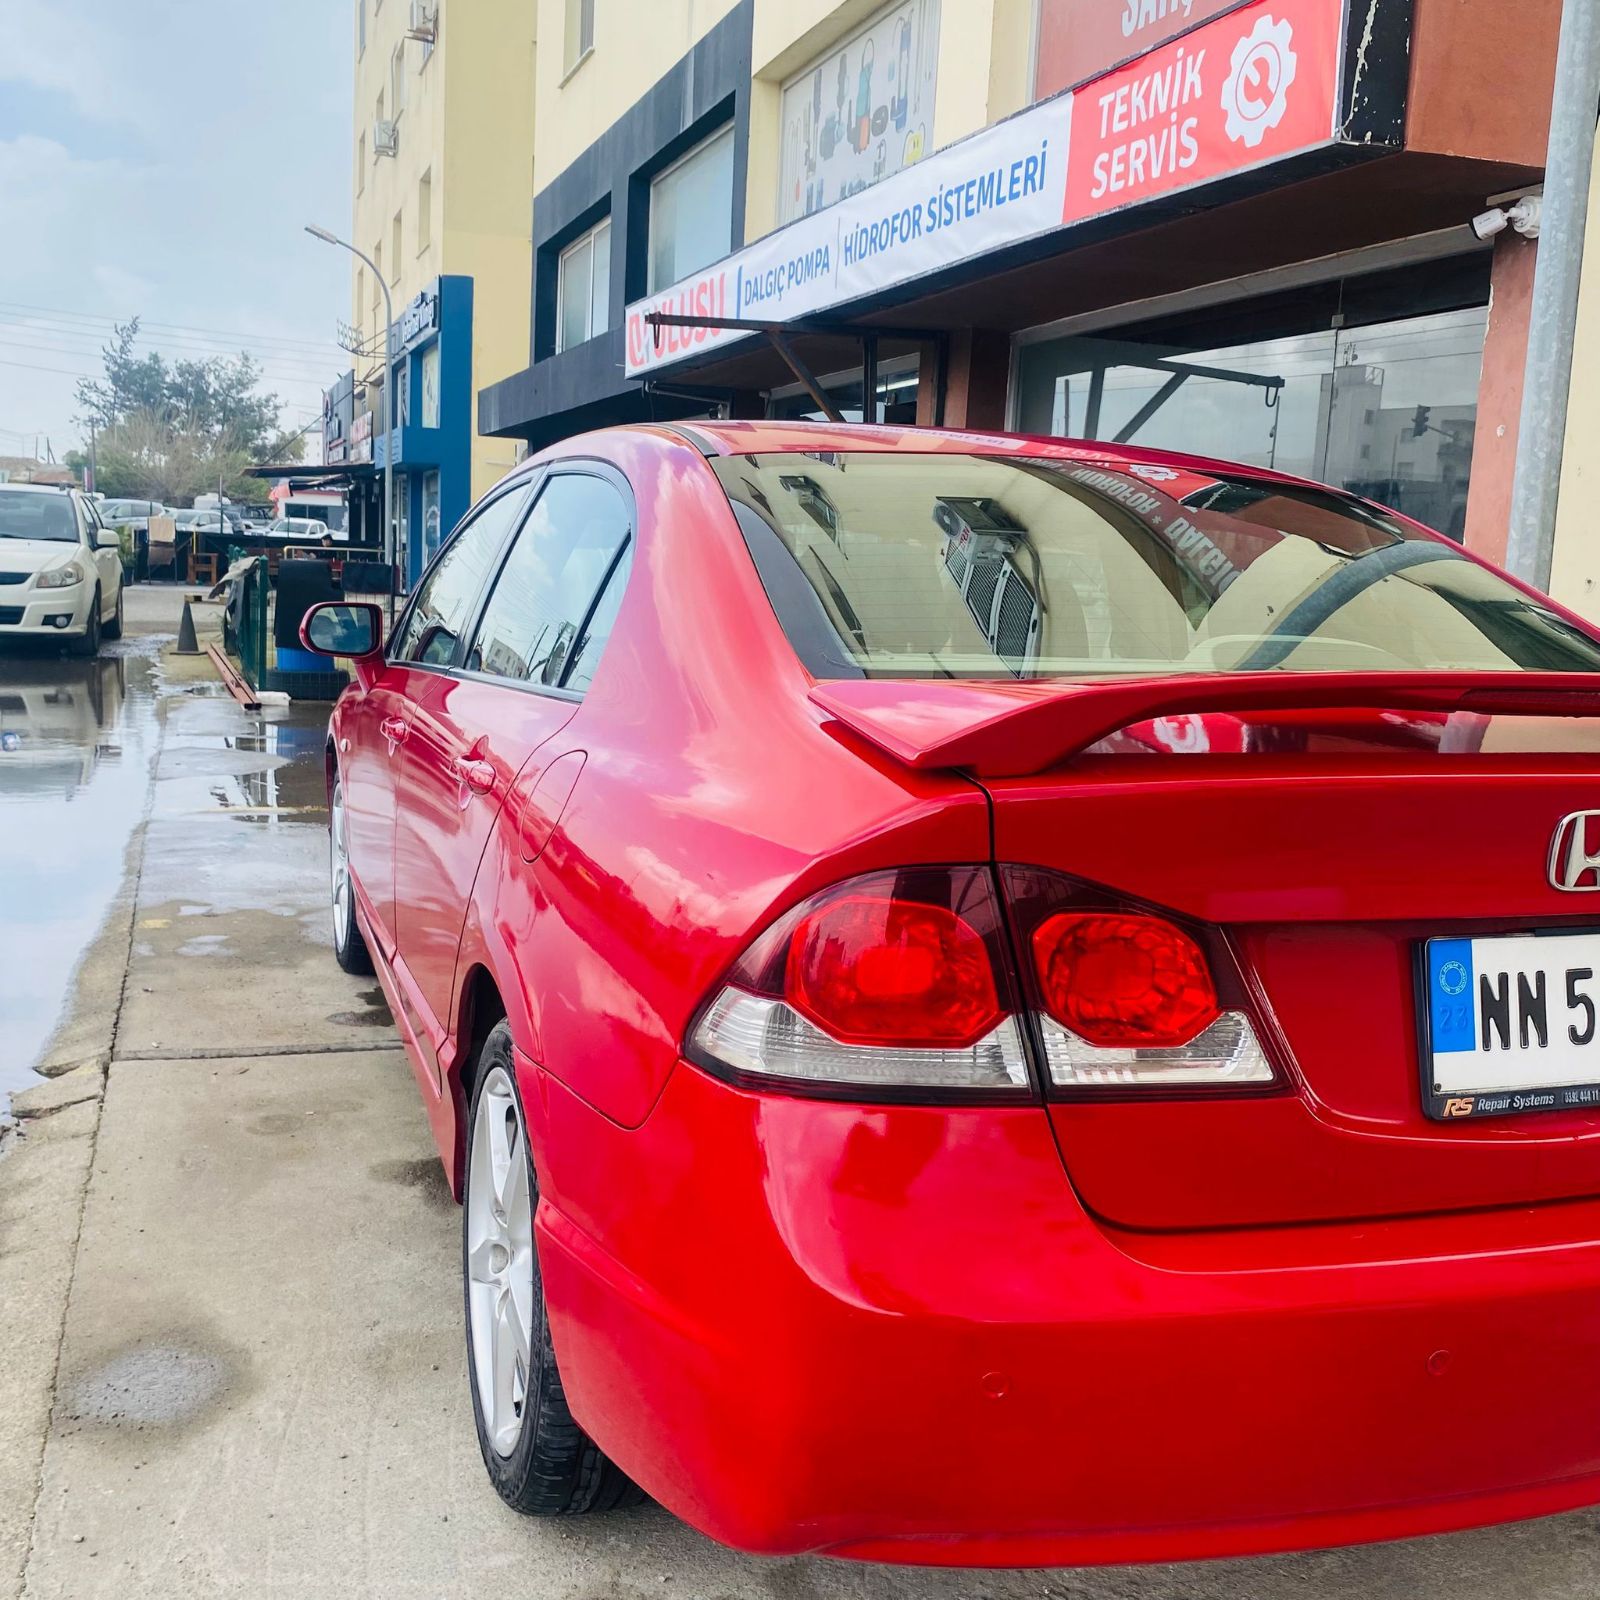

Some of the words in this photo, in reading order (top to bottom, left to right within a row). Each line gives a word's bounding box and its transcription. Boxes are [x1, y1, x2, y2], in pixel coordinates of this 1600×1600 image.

[1099, 47, 1206, 139] TEKNİK
[1091, 112, 1198, 198] SERVİS
[844, 202, 923, 267] HİDROFOR
[926, 139, 1048, 234] SİSTEMLERİ
[745, 264, 785, 306] DALGIÇ
[787, 244, 830, 290] POMPA
[1480, 970, 1548, 1051] NN
[1565, 967, 1595, 1046] 5
[1442, 1097, 1475, 1117] RS
[1478, 1098, 1511, 1112] Repair
[1513, 1094, 1555, 1110] Systems
